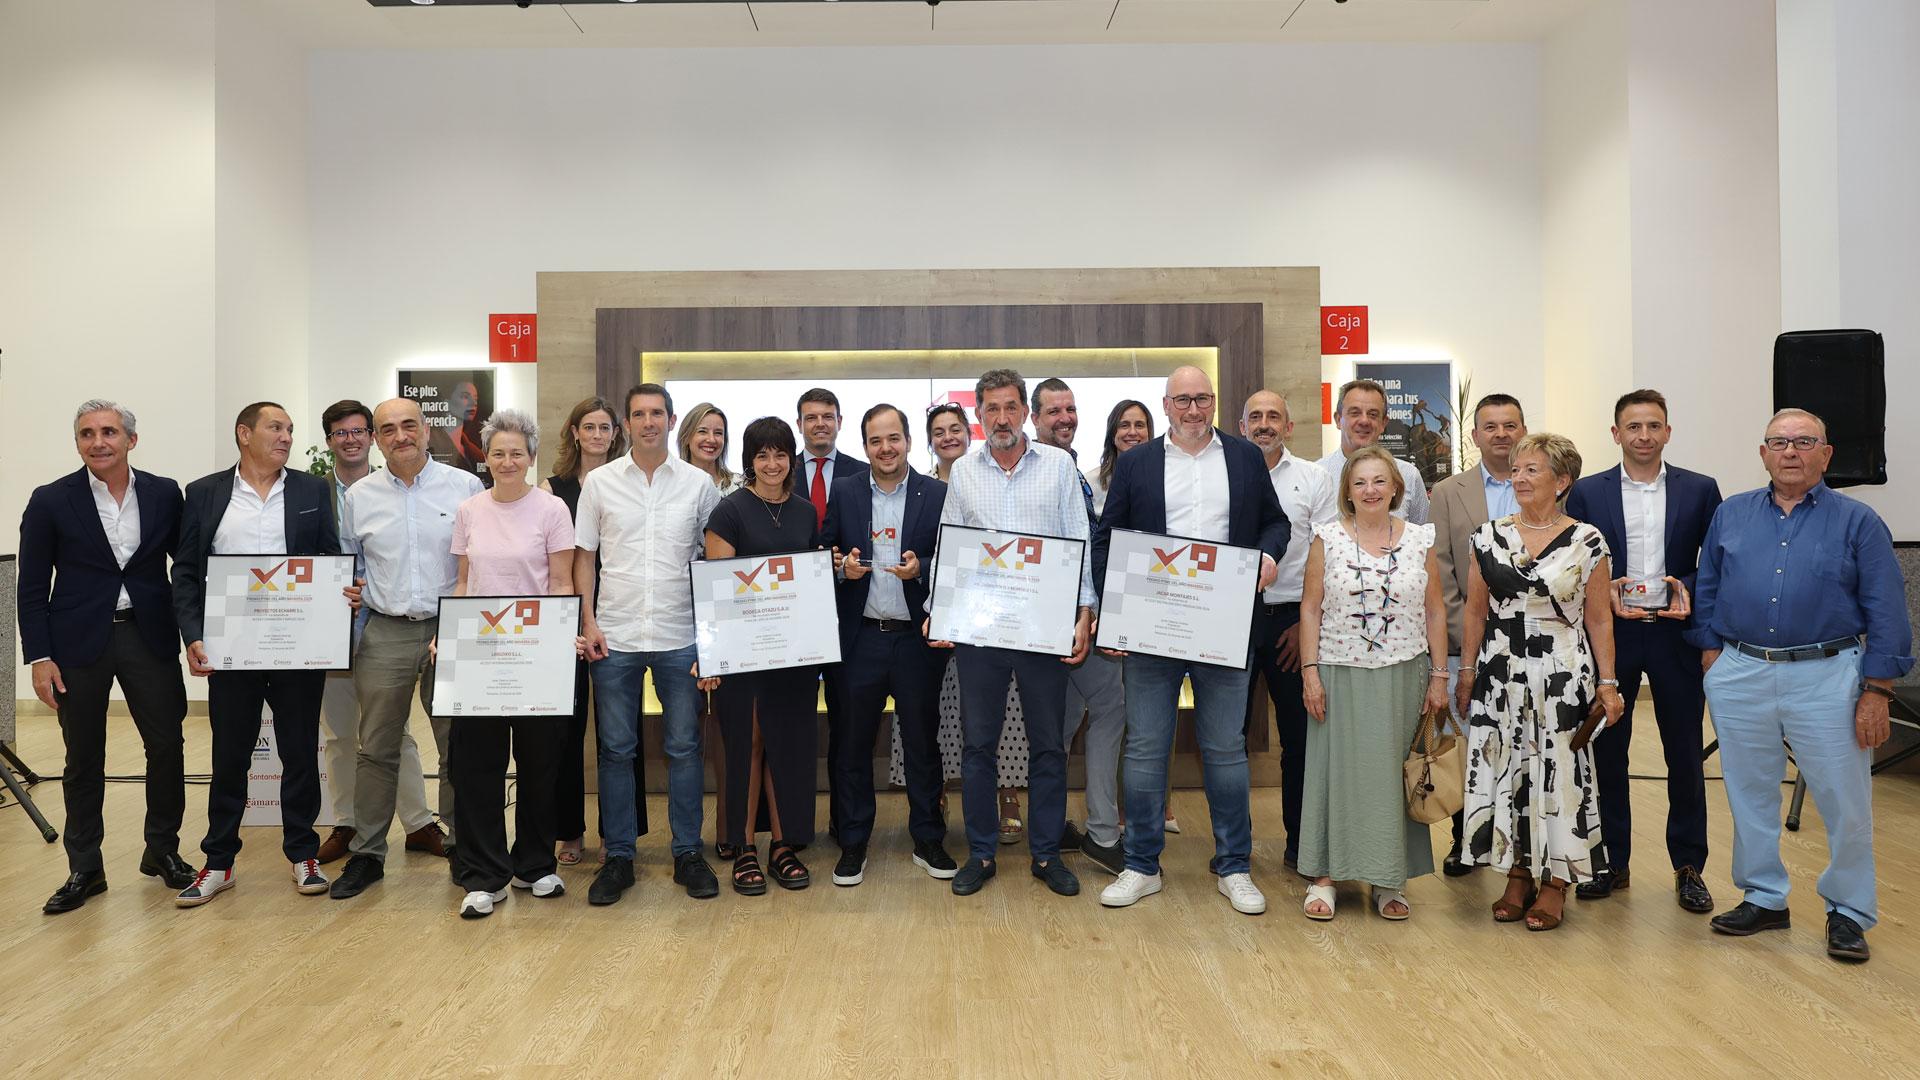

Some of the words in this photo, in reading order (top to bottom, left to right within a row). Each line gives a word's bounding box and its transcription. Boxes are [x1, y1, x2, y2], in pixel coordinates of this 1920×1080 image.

[1327, 313, 1361, 331] Caja
[497, 321, 531, 339] Caja
[1339, 336, 1349, 350] 2
[511, 344, 517, 358] 1
[1385, 379, 1401, 390] una
[403, 386, 418, 397] Ese
[420, 385, 438, 398] plus
[1404, 394, 1418, 404] tus
[422, 402, 448, 412] marca
[249, 773, 282, 781] Santande
